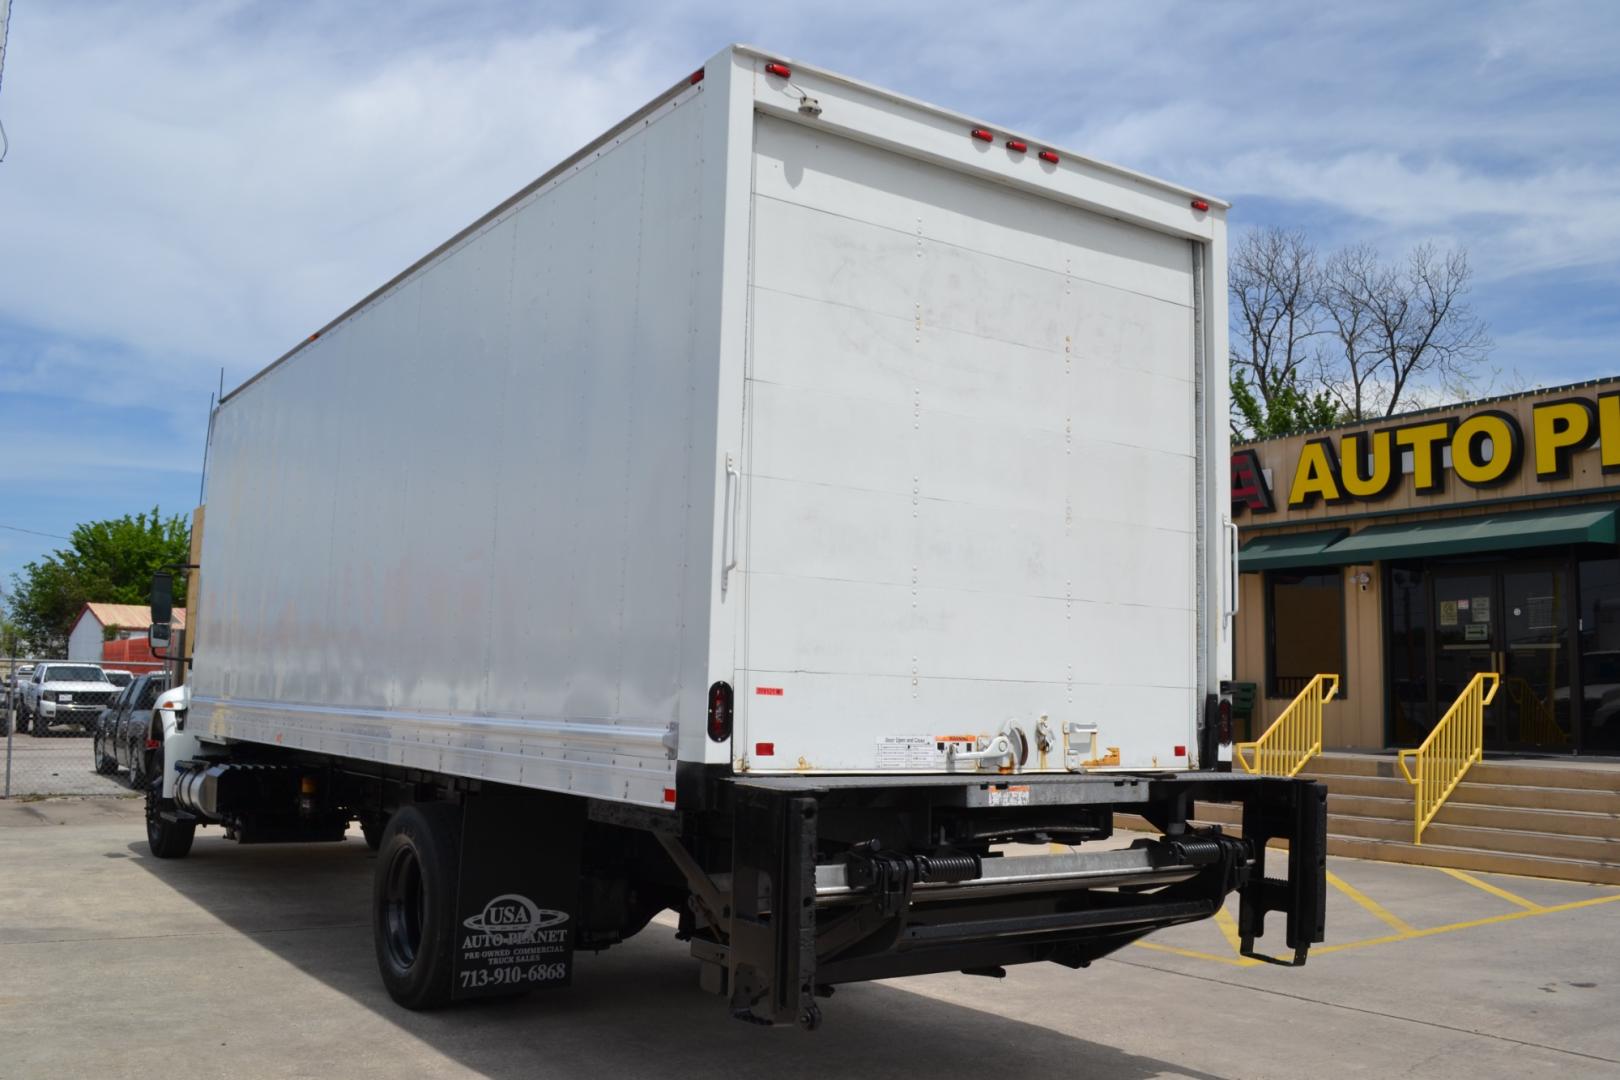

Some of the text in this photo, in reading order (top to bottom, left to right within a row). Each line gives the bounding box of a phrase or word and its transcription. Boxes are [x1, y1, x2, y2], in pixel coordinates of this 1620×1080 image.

[1288, 411, 1521, 508] AUTO
[489, 905, 529, 924] USA
[487, 954, 541, 965] TRUCK SALES
[513, 945, 565, 955] COMMERCIAL
[460, 962, 566, 988] 713-910-6868
